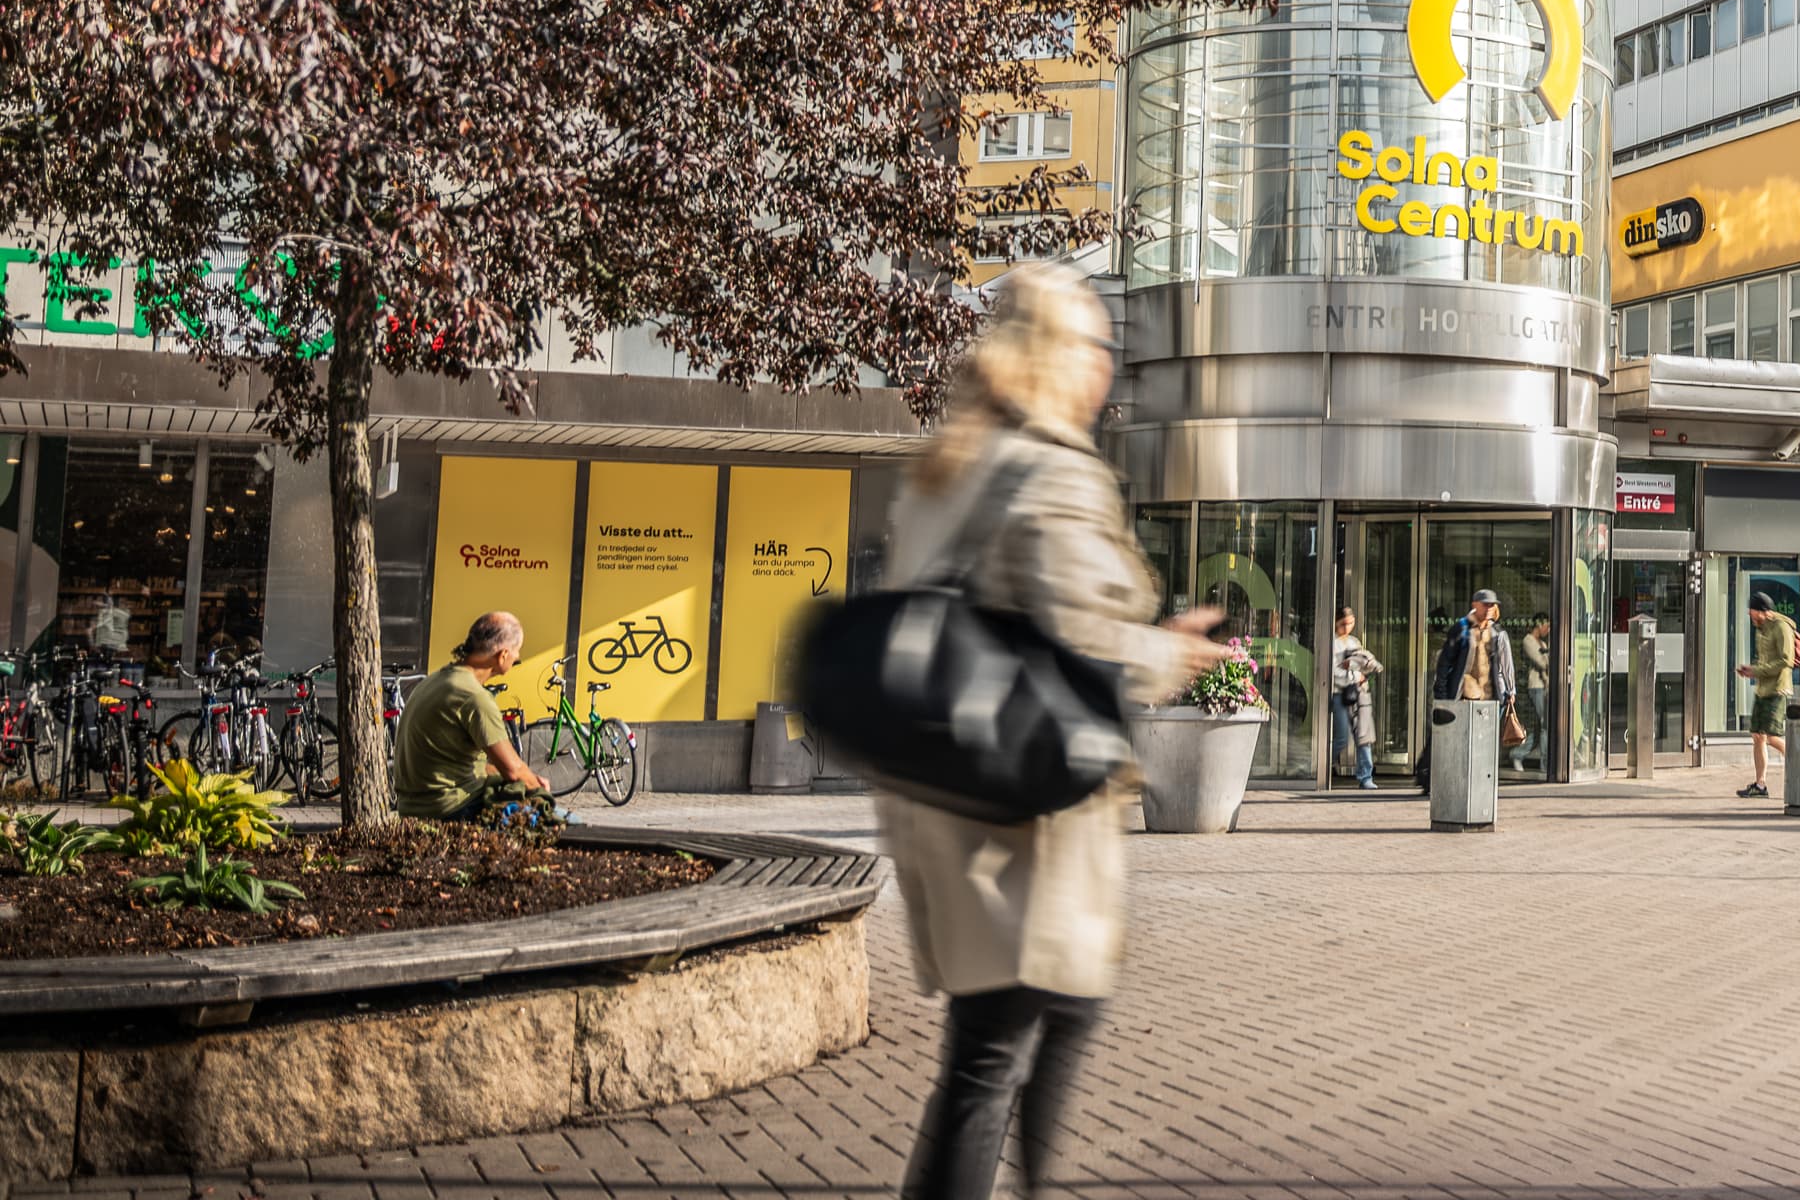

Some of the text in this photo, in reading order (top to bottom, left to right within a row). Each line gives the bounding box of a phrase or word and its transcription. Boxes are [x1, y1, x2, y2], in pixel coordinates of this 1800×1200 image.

[1337, 129, 1498, 192] Solna
[1355, 185, 1584, 256] Centrum
[1624, 208, 1692, 248] dinsko
[1419, 306, 1583, 348] HOLLGTAN
[1623, 495, 1661, 510] Entré
[599, 525, 693, 538] Visste du att...
[480, 544, 521, 557] Solna
[598, 544, 608, 552] En
[609, 544, 645, 553] tredjedel
[754, 540, 788, 556] HÄR
[484, 556, 549, 569] Centrum
[597, 553, 689, 563] pendlingen inom Solna
[753, 558, 815, 568] kan du pumpa
[597, 562, 616, 570] Stad
[617, 562, 634, 570] sker
[635, 563, 655, 571] med
[752, 568, 772, 576] dina
